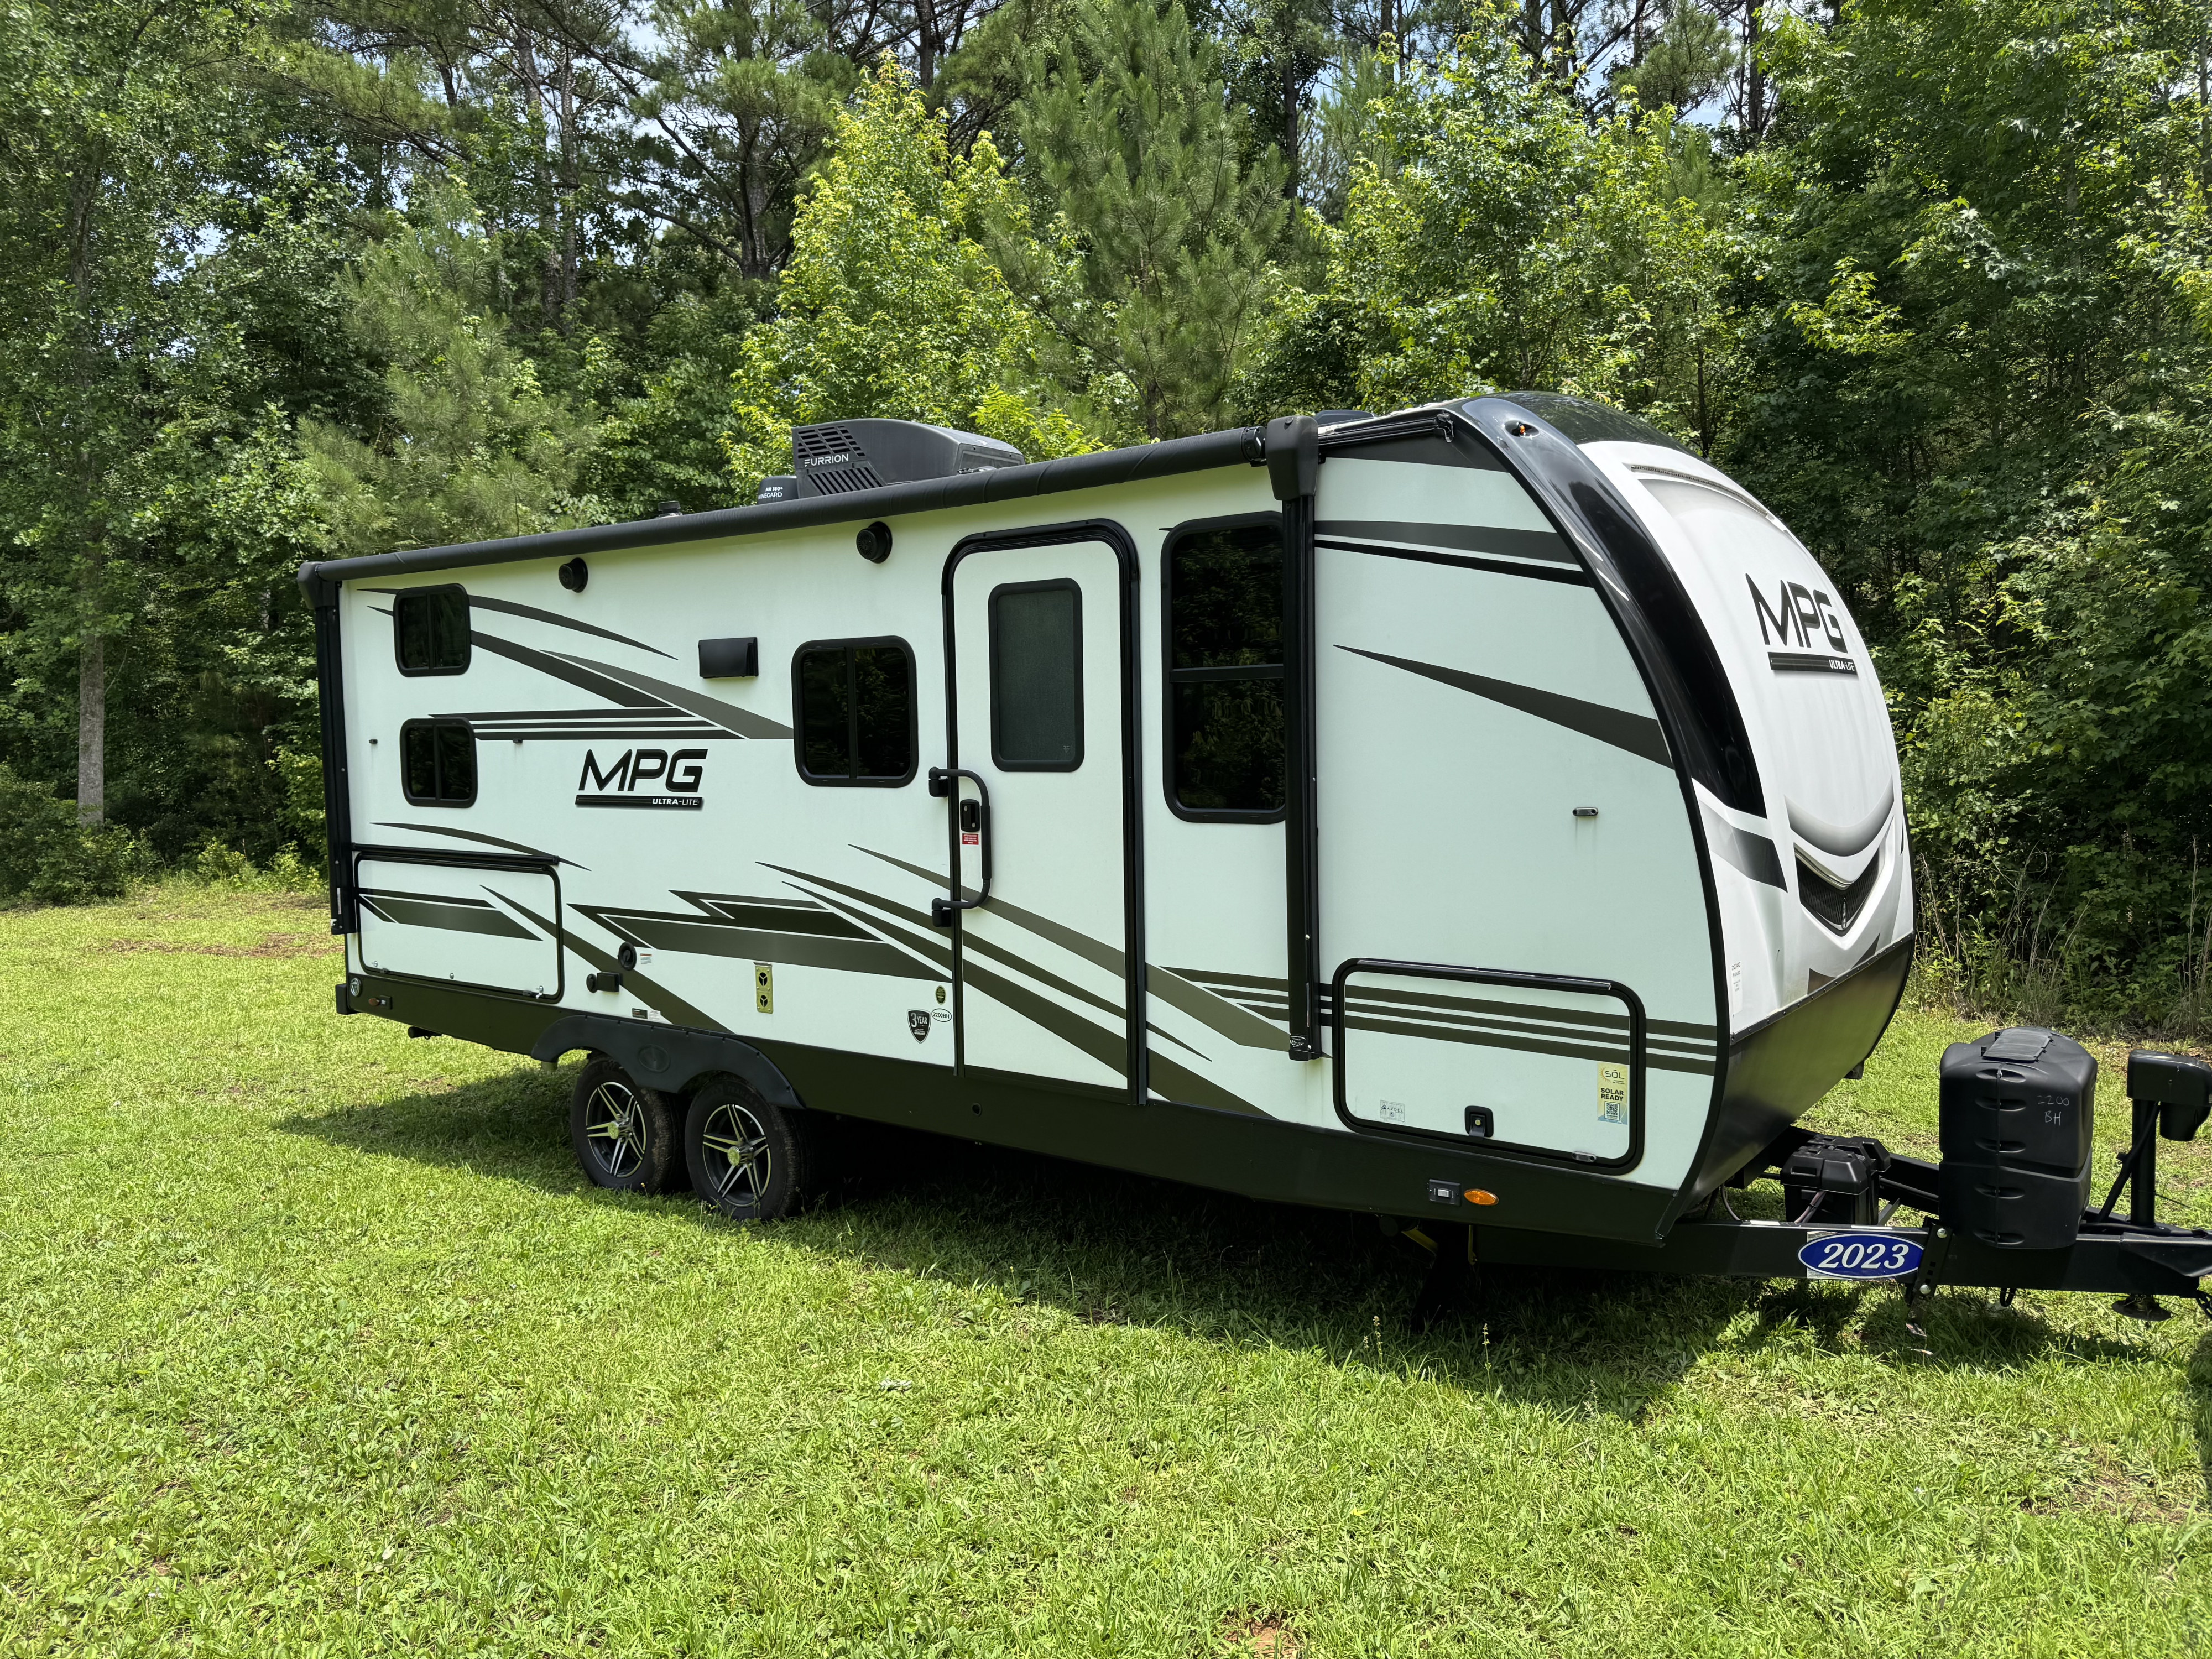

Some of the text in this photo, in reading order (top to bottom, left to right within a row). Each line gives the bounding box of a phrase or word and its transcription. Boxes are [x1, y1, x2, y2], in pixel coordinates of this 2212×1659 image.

[804, 453, 848, 467] FURRION
[1745, 573, 1848, 654] MPG
[1829, 659, 1855, 671] ULTRA-LITE
[578, 749, 708, 793] MPG
[652, 797, 699, 806] ULTRA-LITE
[910, 1012, 927, 1027] 3 YEAR
[1600, 1087, 1624, 1096] SOLAR
[2044, 1110, 2062, 1126] BH
[1818, 1243, 1910, 1269] 2023
